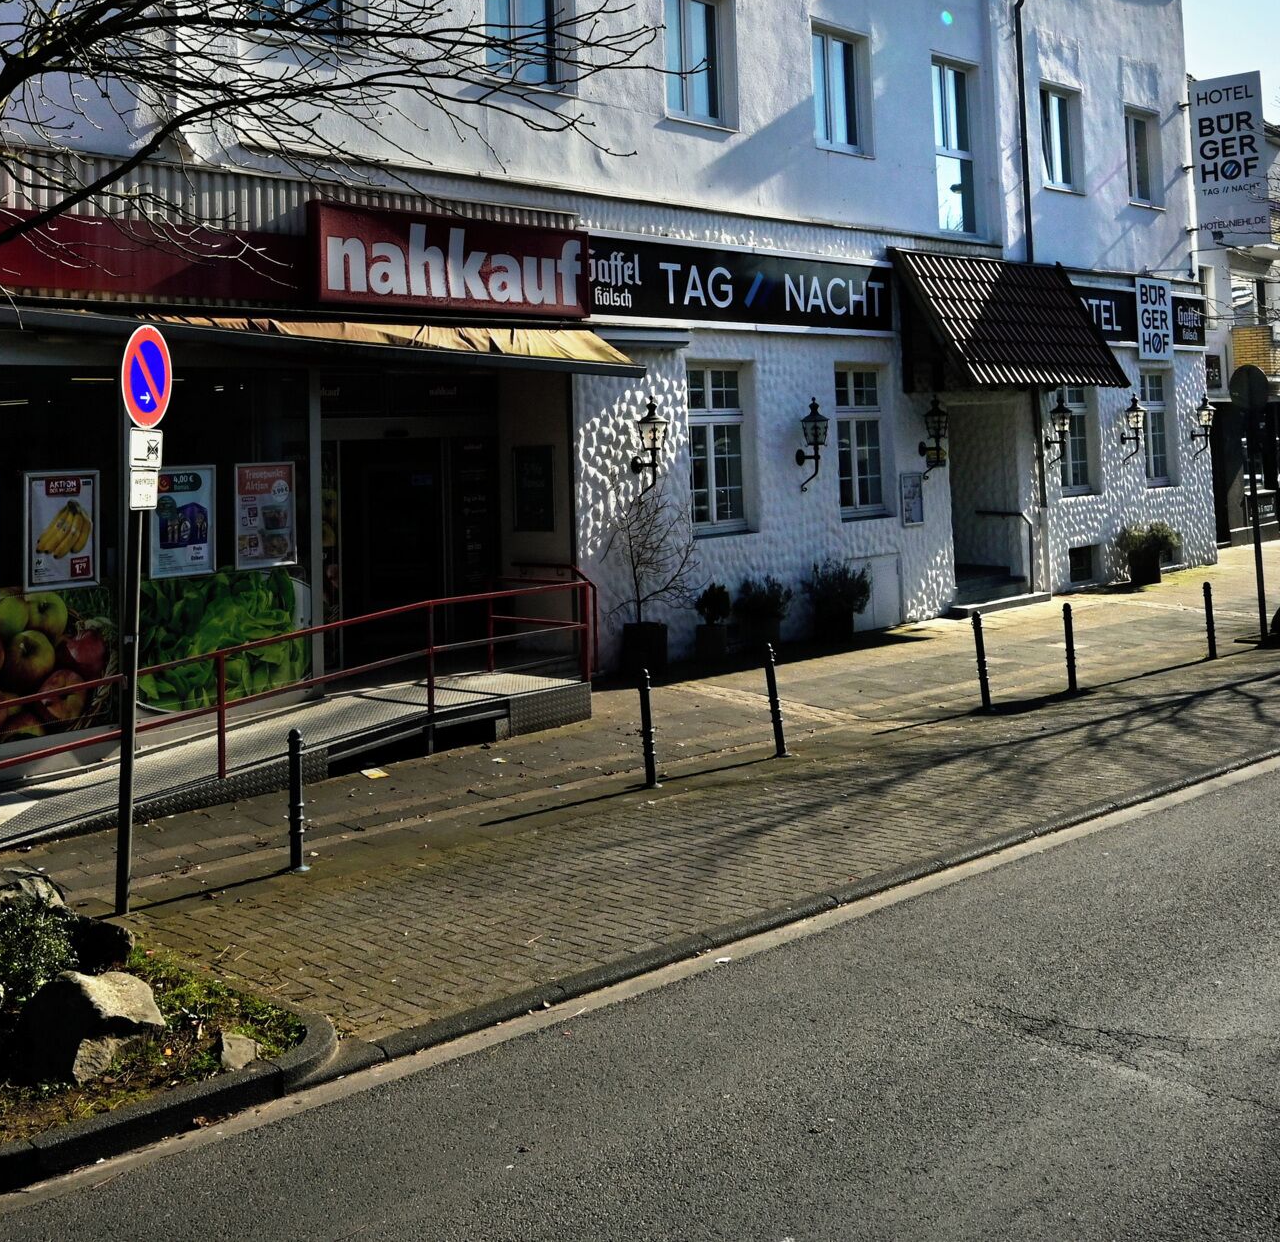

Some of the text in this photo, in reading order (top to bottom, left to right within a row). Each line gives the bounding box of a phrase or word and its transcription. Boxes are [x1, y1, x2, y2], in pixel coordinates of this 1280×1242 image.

[1197, 85, 1253, 106] HOTEL
[1198, 111, 1255, 138] BÜR
[1200, 135, 1258, 160] GER
[1201, 157, 1259, 183] HOF
[1202, 187, 1219, 196] TAG
[1232, 182, 1261, 193] NACHT
[326, 223, 581, 306] nahkauf
[659, 262, 733, 308] TAG
[784, 274, 885, 317] NACHT
[1080, 297, 1122, 331] TEL
[1141, 309, 1168, 330] GER
[1142, 333, 1169, 354] HOF
